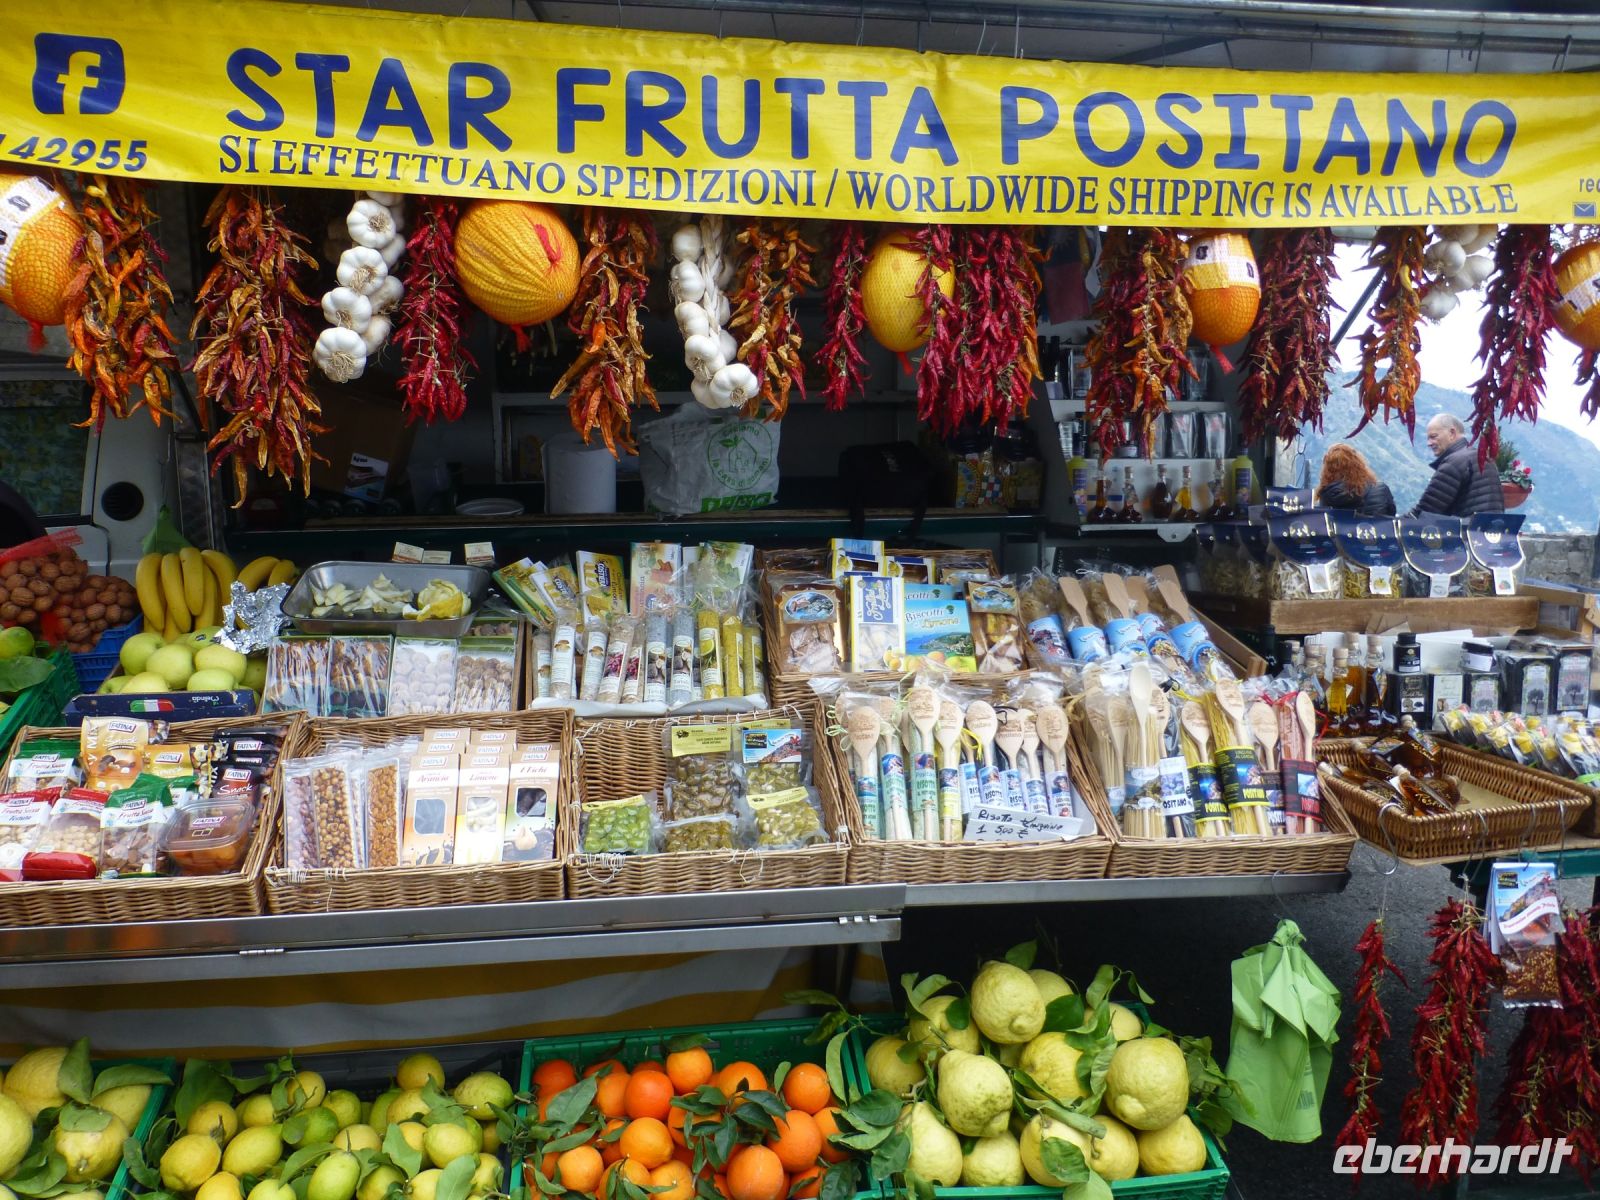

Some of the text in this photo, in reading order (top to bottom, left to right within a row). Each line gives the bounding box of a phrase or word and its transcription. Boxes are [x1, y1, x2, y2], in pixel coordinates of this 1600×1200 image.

[226, 47, 1517, 178] STAR FRUTTA POSITANO
[0, 134, 147, 172] 42955
[219, 135, 260, 174] SI
[270, 141, 567, 194] EFFETTUANO
[576, 164, 817, 207] SPEDIZIONI
[848, 170, 1099, 214] WORLDWIDE
[1107, 177, 1275, 217] SHIPPING
[1283, 183, 1312, 218] IS
[1320, 184, 1518, 218] AVAILABLE
[905, 607, 944, 622] Biscotti
[217, 782, 253, 795] Snack
[1162, 797, 1187, 809] OSITANO
